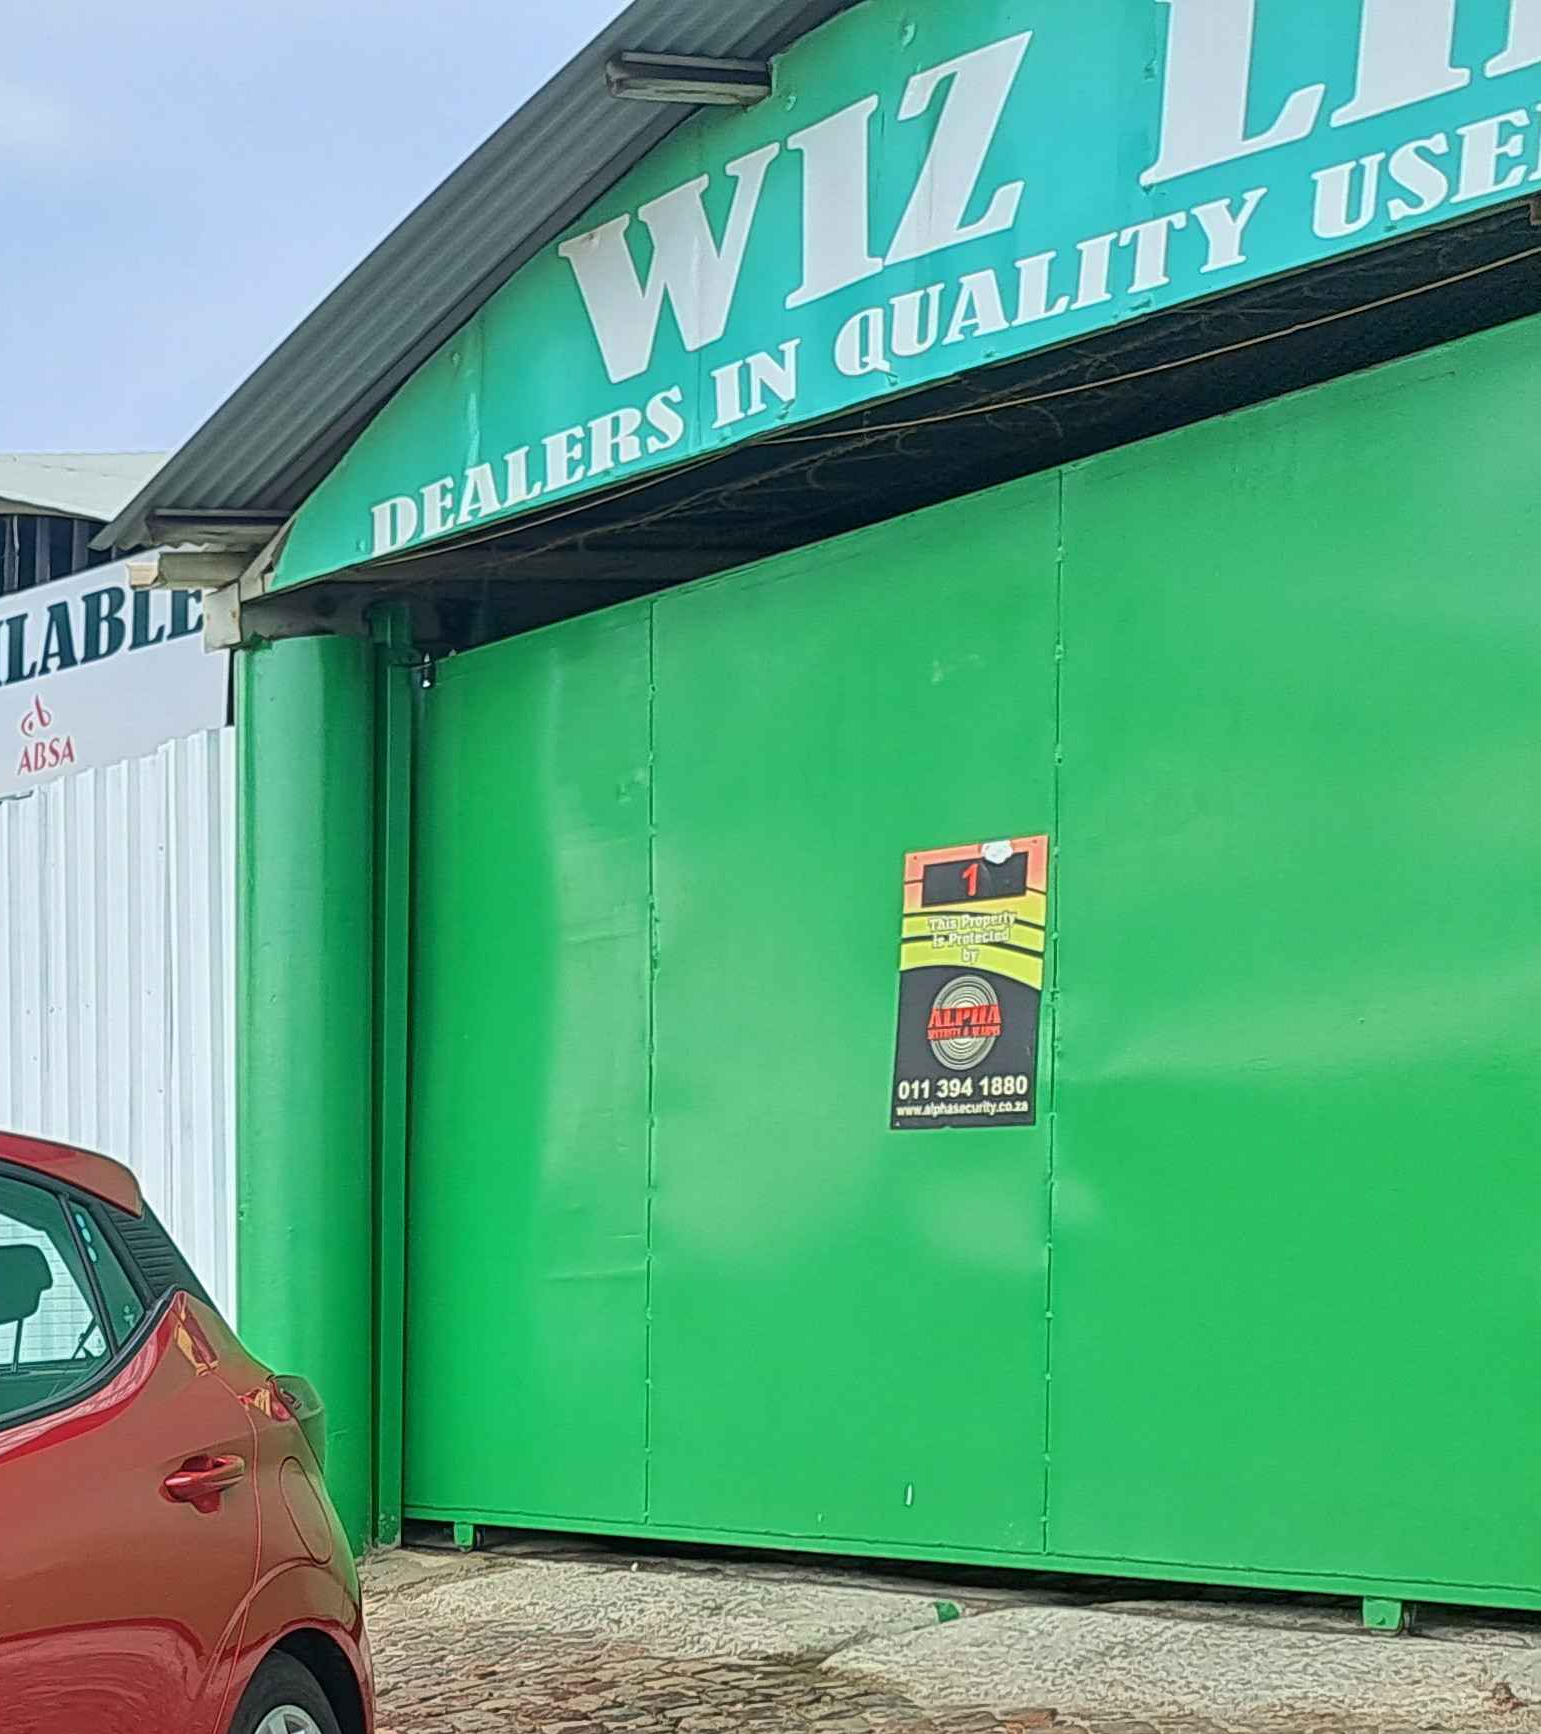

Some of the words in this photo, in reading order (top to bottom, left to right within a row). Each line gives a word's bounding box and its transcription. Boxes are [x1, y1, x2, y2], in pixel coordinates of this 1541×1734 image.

[558, 30, 1034, 384] WIZ
[369, 386, 685, 557] DEALERS
[710, 339, 802, 430] IN
[834, 187, 1268, 382] QUALITY
[1311, 102, 1541, 240] USE
[17, 736, 76, 776] ABSA
[961, 863, 980, 897] 1
[929, 917, 957, 932] This
[961, 911, 1015, 929] Property
[948, 927, 1009, 946] Protected
[962, 947, 979, 964] by
[928, 1005, 1002, 1028] ALPHA
[898, 1079, 930, 1099] 011
[936, 1076, 974, 1098] 394
[978, 1074, 1028, 1096] 1880
[896, 1100, 1029, 1118] www.alphasecurity.co.za
